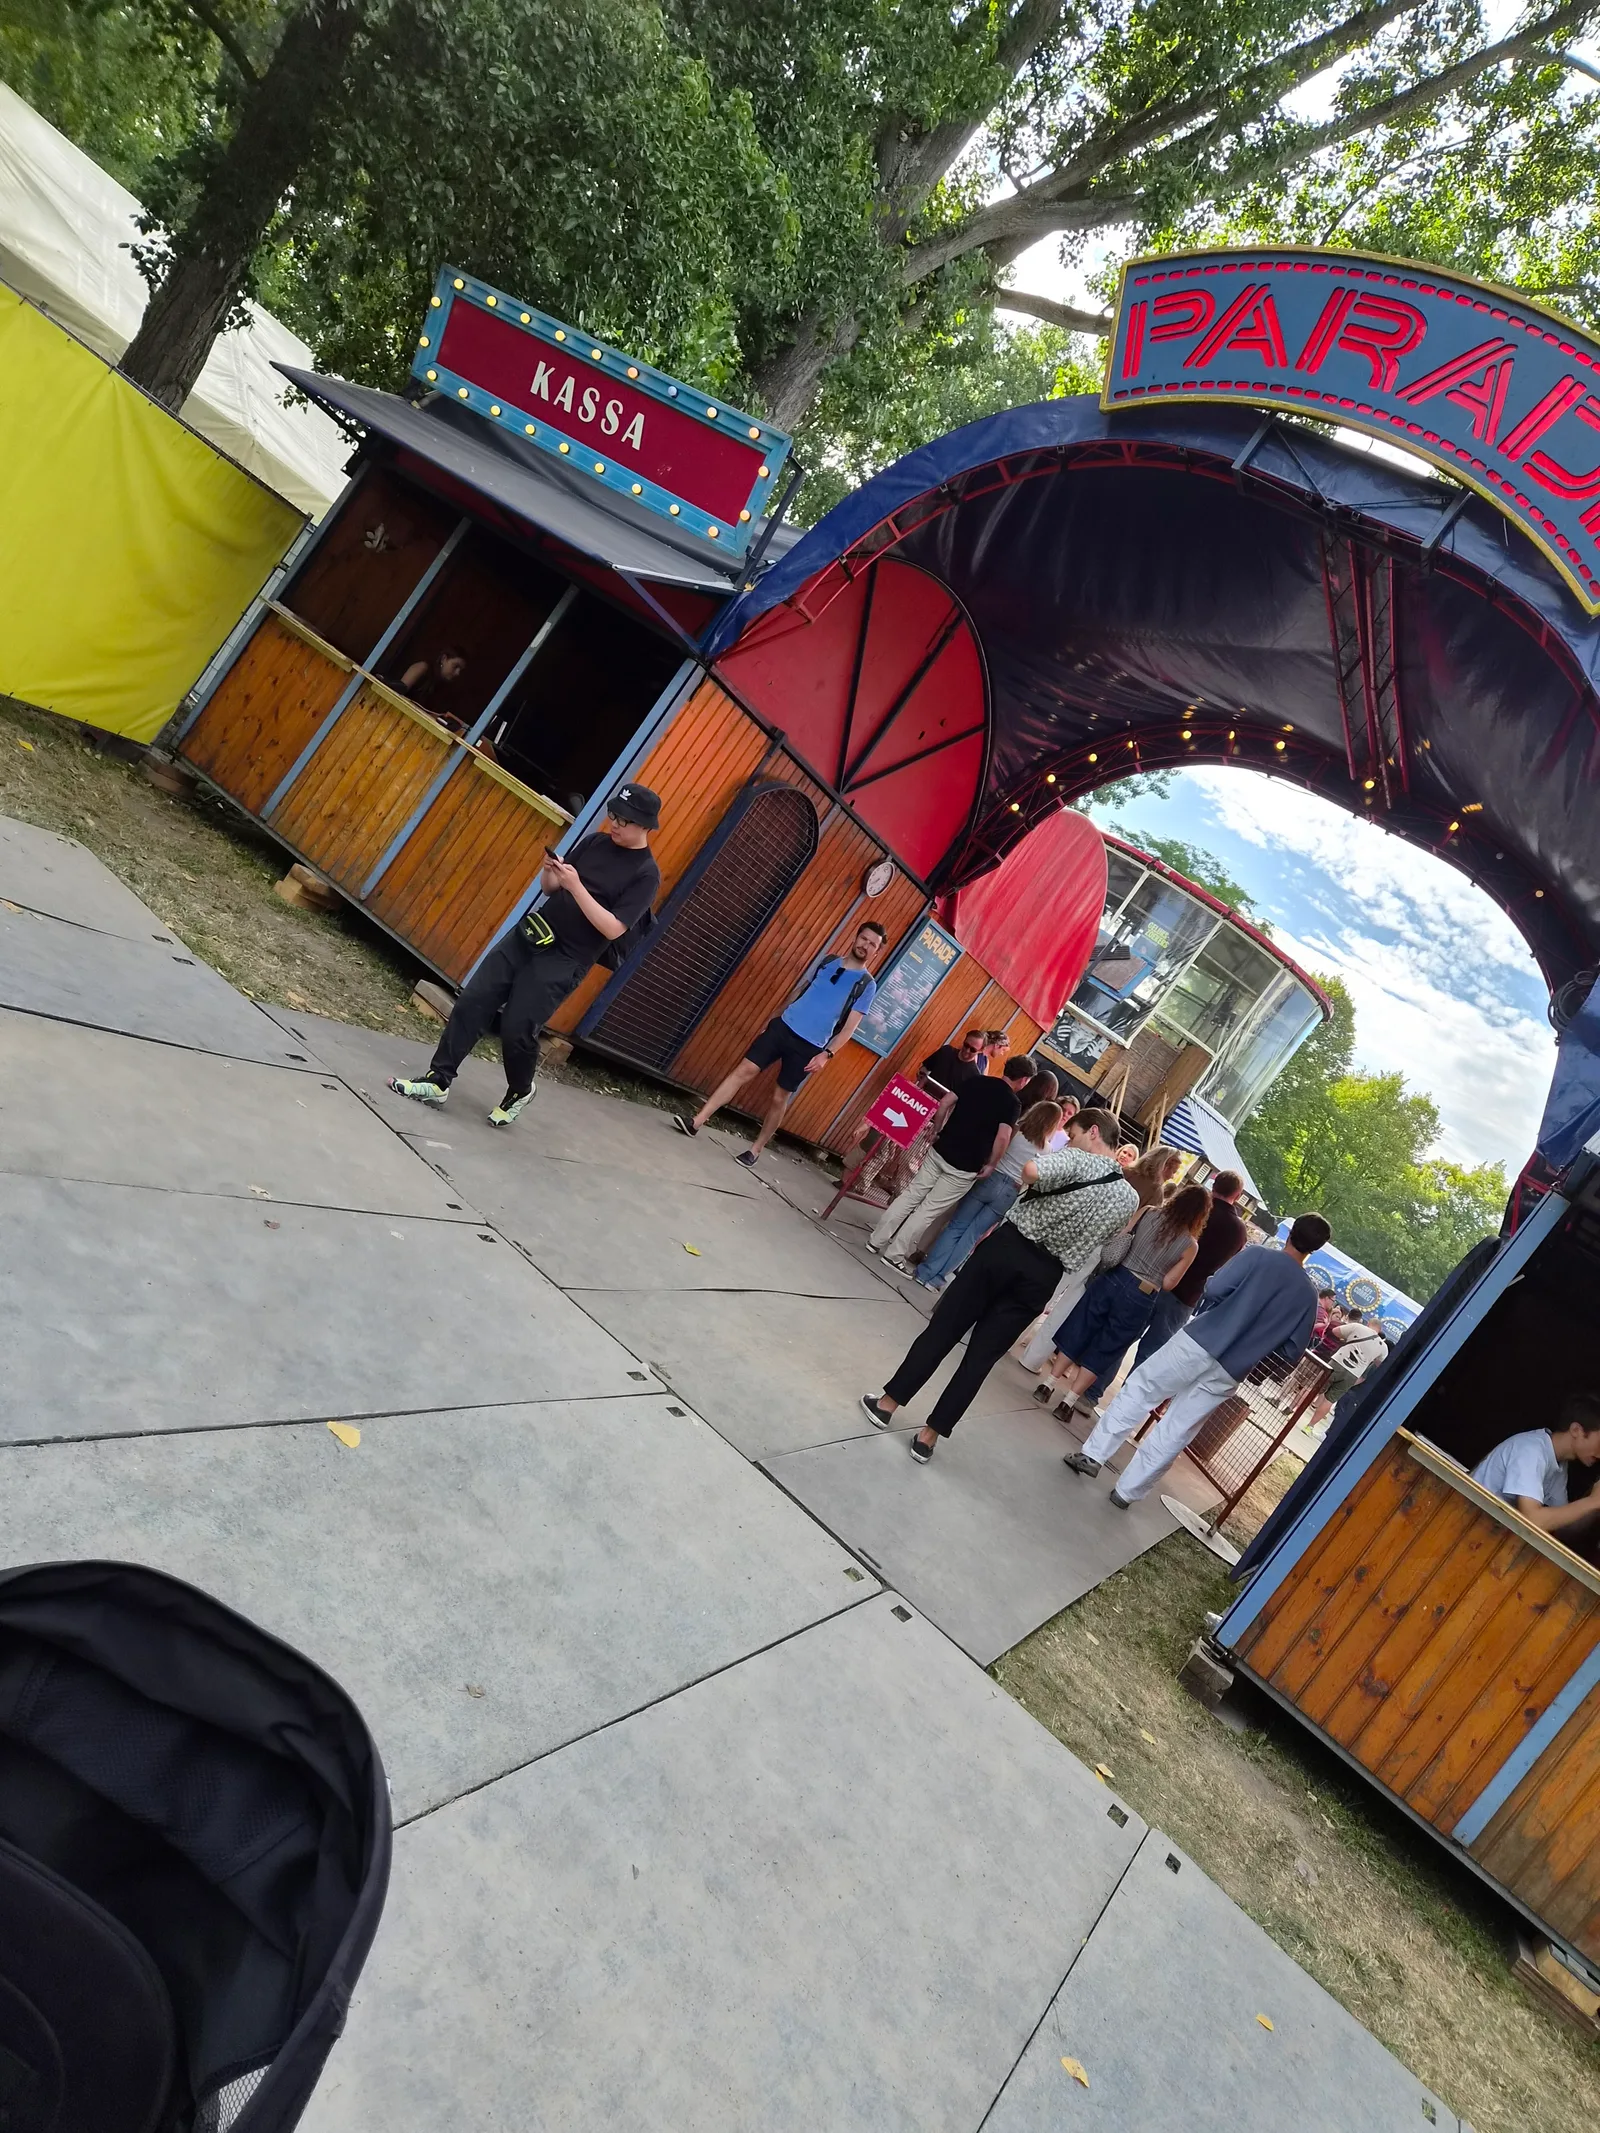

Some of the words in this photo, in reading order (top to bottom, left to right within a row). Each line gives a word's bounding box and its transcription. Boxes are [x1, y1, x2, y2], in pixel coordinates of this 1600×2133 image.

[530, 360, 645, 451] KASSA
[918, 926, 957, 965] PARADE
[891, 1086, 929, 1116] INGANG
